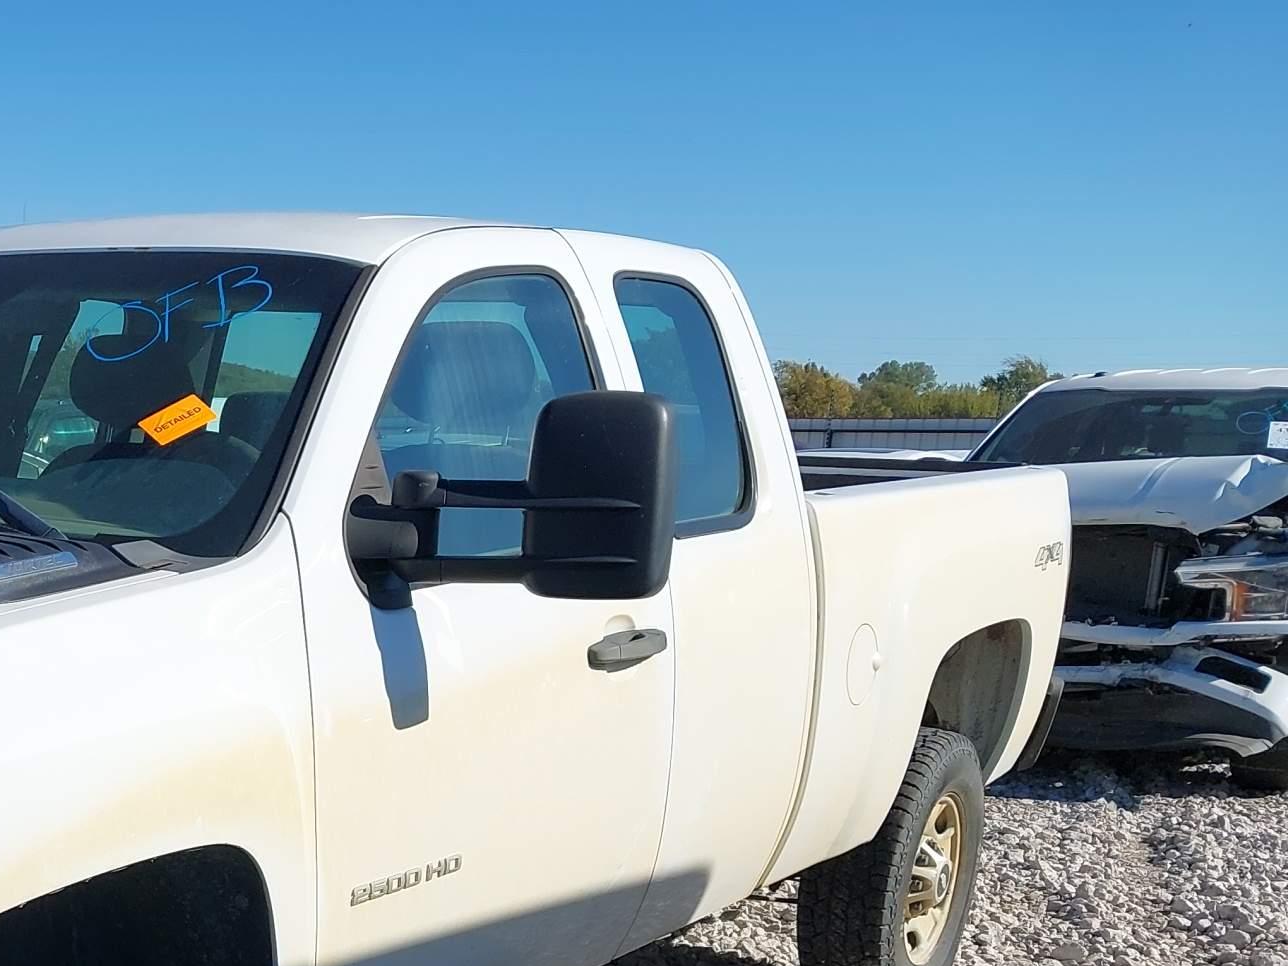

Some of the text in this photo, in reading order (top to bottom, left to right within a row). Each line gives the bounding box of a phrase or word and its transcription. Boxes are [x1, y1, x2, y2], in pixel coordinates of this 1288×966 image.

[153, 406, 202, 434] DETAILED
[350, 854, 462, 907] 2500 HD
